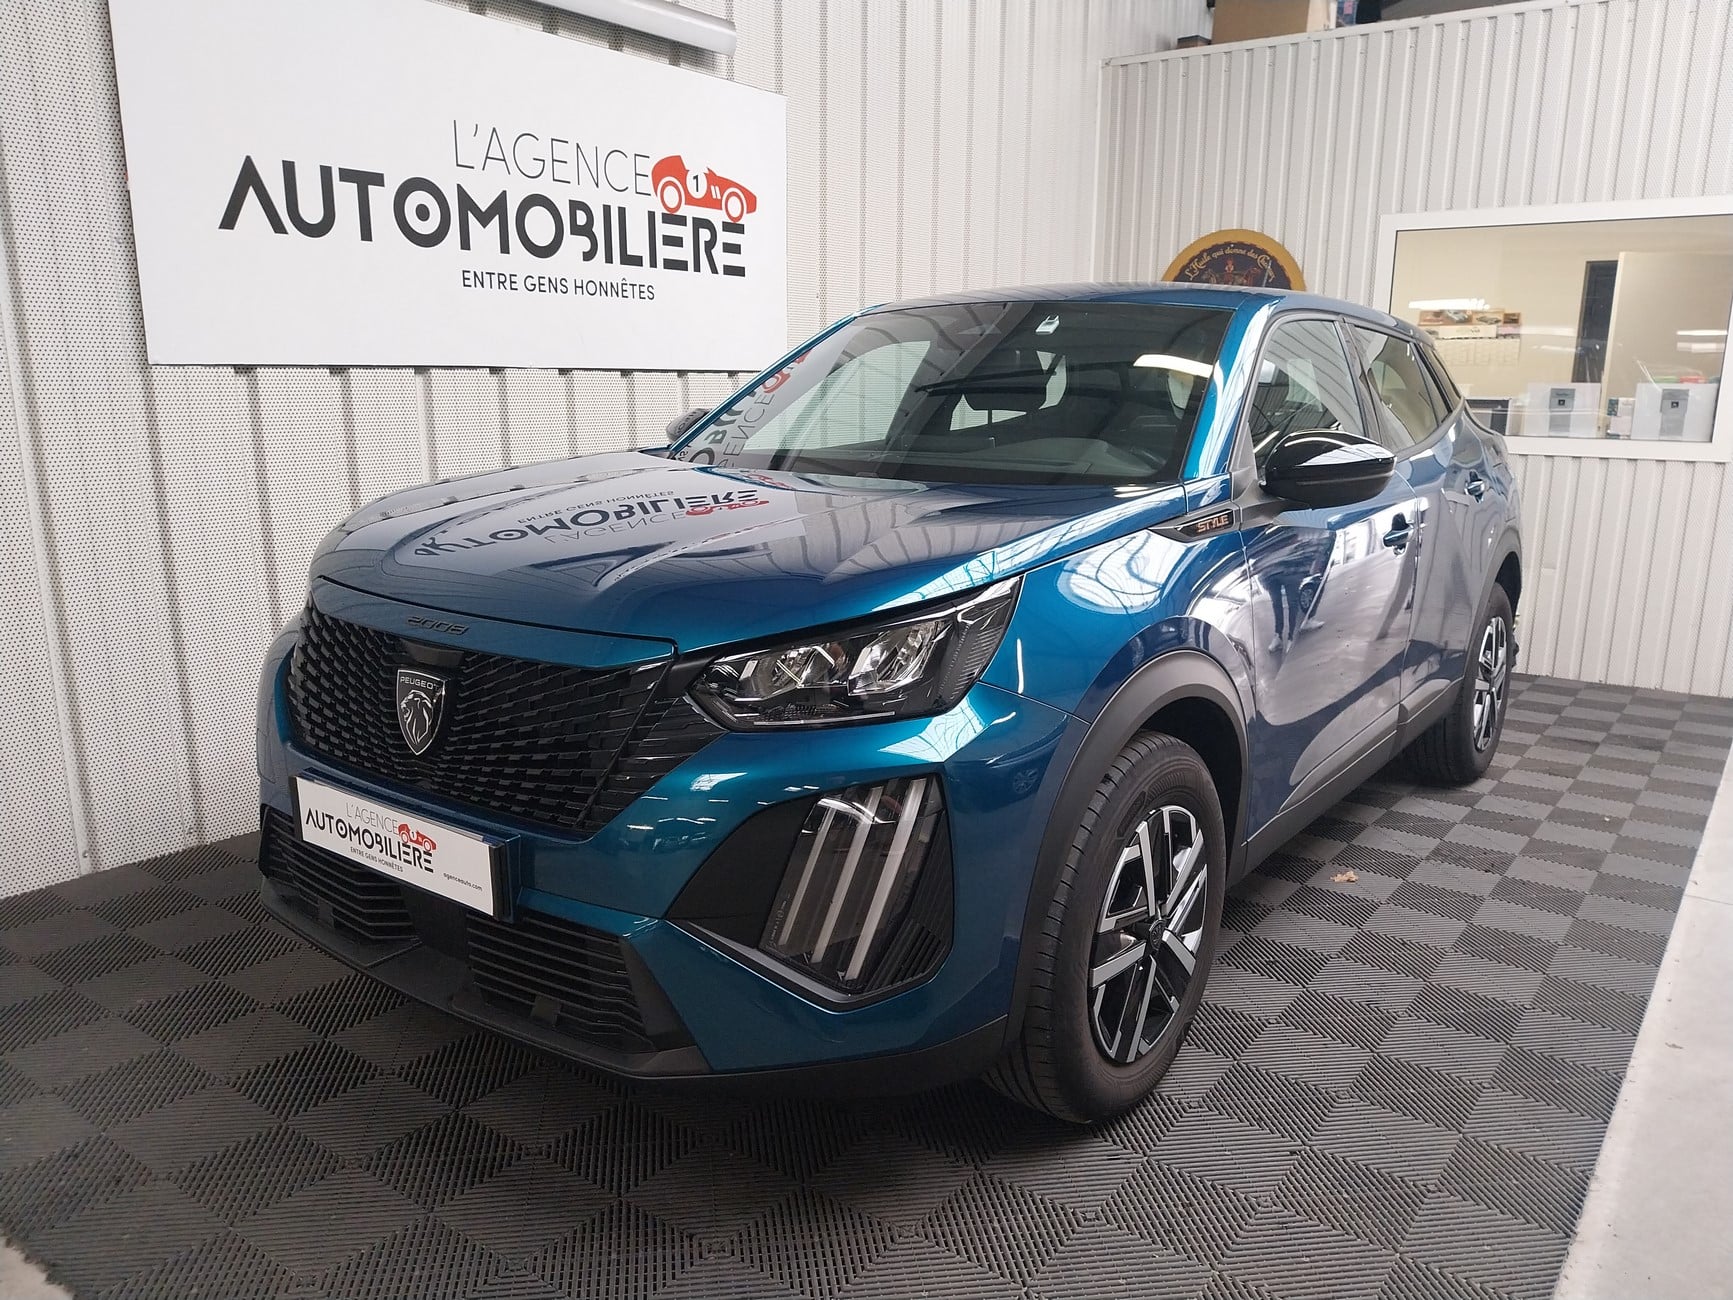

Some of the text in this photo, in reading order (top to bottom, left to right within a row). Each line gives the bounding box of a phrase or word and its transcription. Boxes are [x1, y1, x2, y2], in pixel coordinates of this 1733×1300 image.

[452, 119, 652, 198] L'AGENCE
[217, 155, 747, 278] AUTOMOBILIERE
[1211, 248, 1225, 259] qui
[461, 269, 656, 301] ENTRE GENS HONNÊTES
[1197, 514, 1230, 533] STYLE
[407, 615, 470, 636] 2008
[400, 676, 440, 691] PEUGEOT
[345, 802, 400, 836] L'AGENCE
[305, 807, 434, 874] AUTOMOBILIERE
